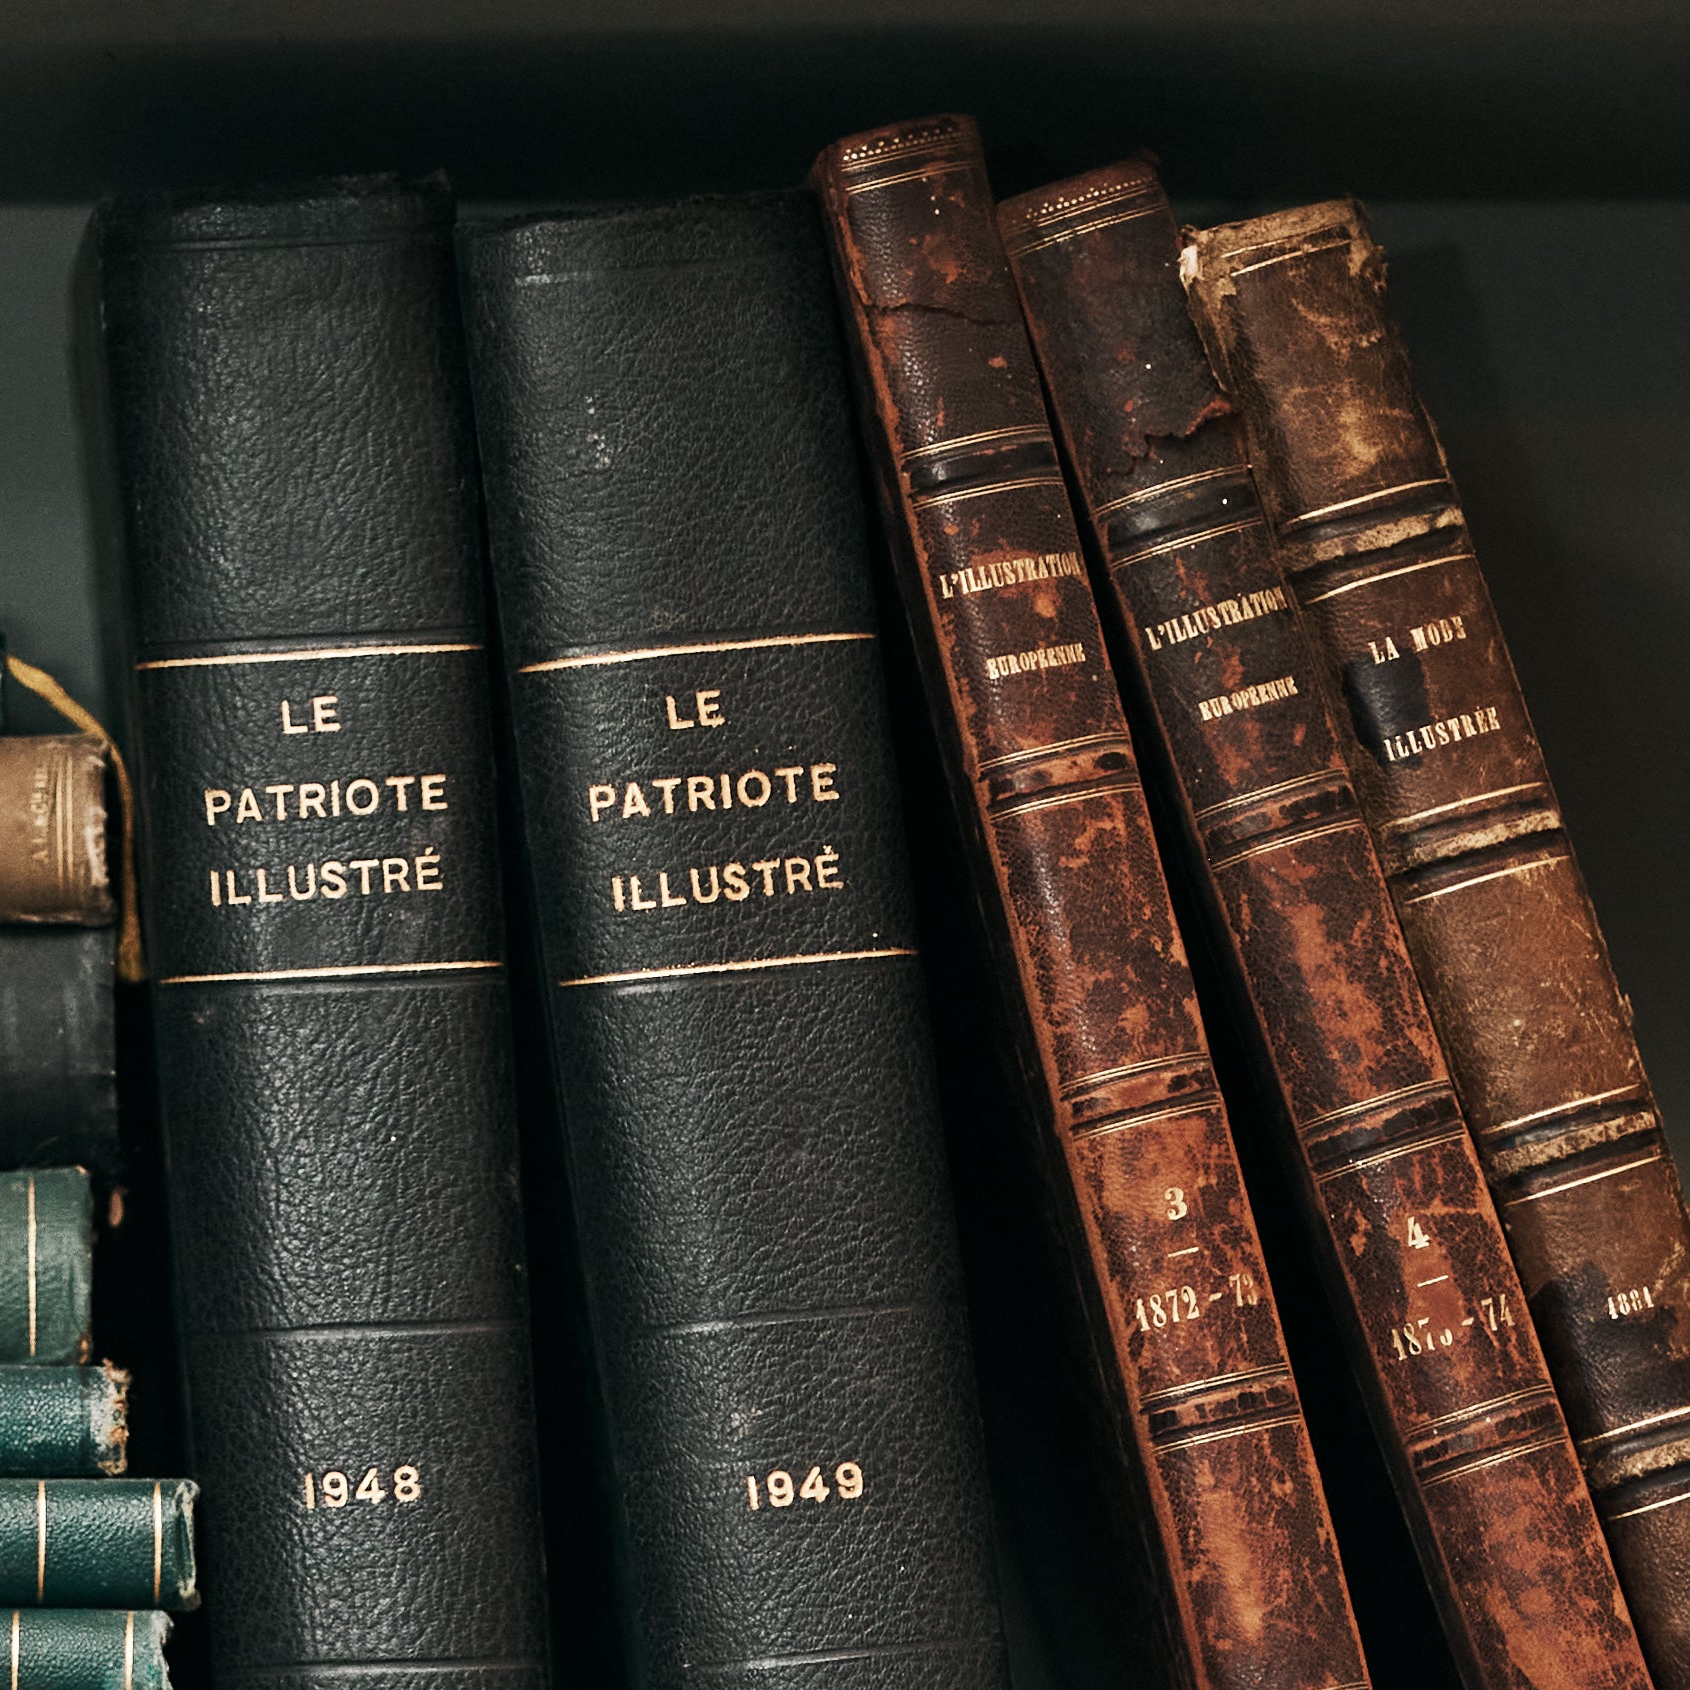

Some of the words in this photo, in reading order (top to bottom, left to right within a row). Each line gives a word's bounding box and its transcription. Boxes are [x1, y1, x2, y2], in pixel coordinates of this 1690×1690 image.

[939, 551, 1081, 599] L'ILLUSTRATION
[1145, 586, 1287, 650] L'ILLUSTRATION
[1368, 637, 1400, 664] LA
[1410, 616, 1467, 652] MODE
[281, 695, 341, 736] LE
[664, 690, 722, 731] LE
[205, 774, 449, 826] PATRIOTE
[588, 762, 840, 823] PATRIOTE
[209, 846, 443, 907] ILLUSTRÉ
[611, 844, 844, 912] ILLUSTRÉ
[1164, 1187, 1187, 1220] 3
[1407, 1216, 1430, 1249] 4
[1136, 1285, 1200, 1332] 1872
[1608, 1286, 1654, 1319] 1881
[305, 1464, 421, 1510] 1948
[746, 1461, 863, 1510] 1949
